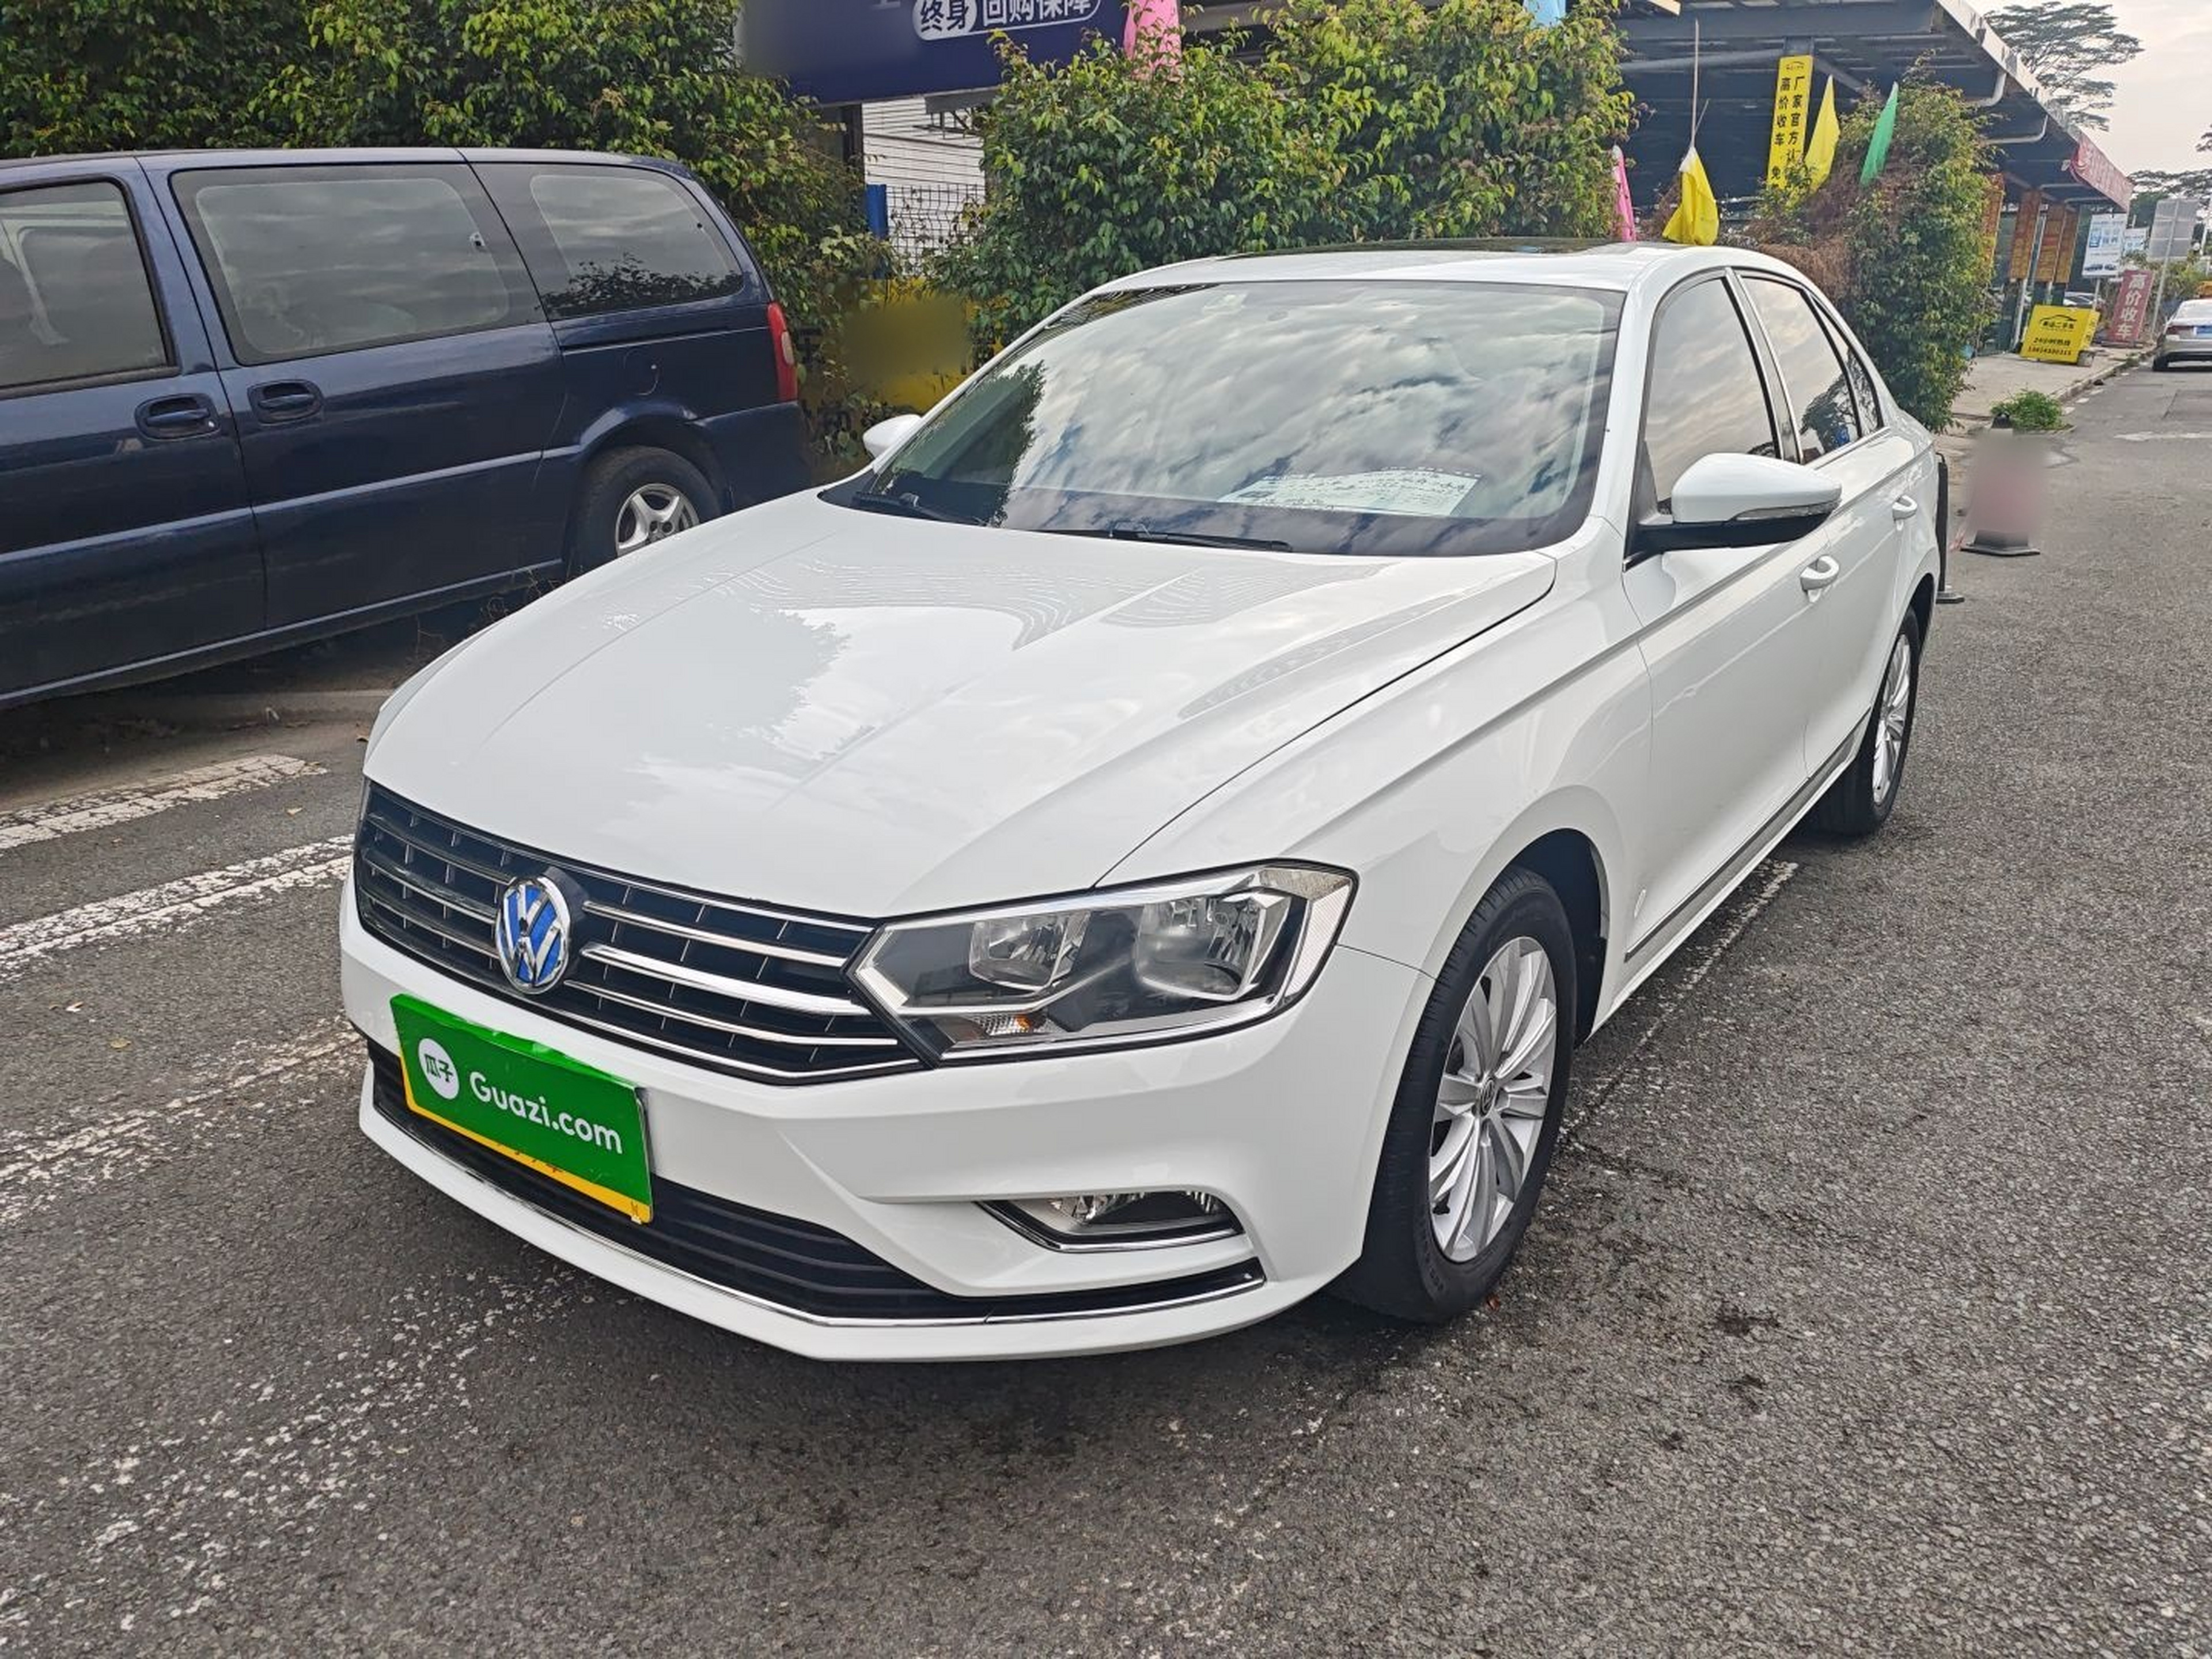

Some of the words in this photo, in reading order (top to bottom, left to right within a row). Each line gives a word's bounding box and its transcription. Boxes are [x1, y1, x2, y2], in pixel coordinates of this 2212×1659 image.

[920, 0, 969, 33] 终身
[1774, 77, 1791, 146] 高价收车
[2115, 274, 2149, 340] 高价收车
[424, 1053, 454, 1083] 瓜子
[469, 1071, 623, 1154] Guazi.com
